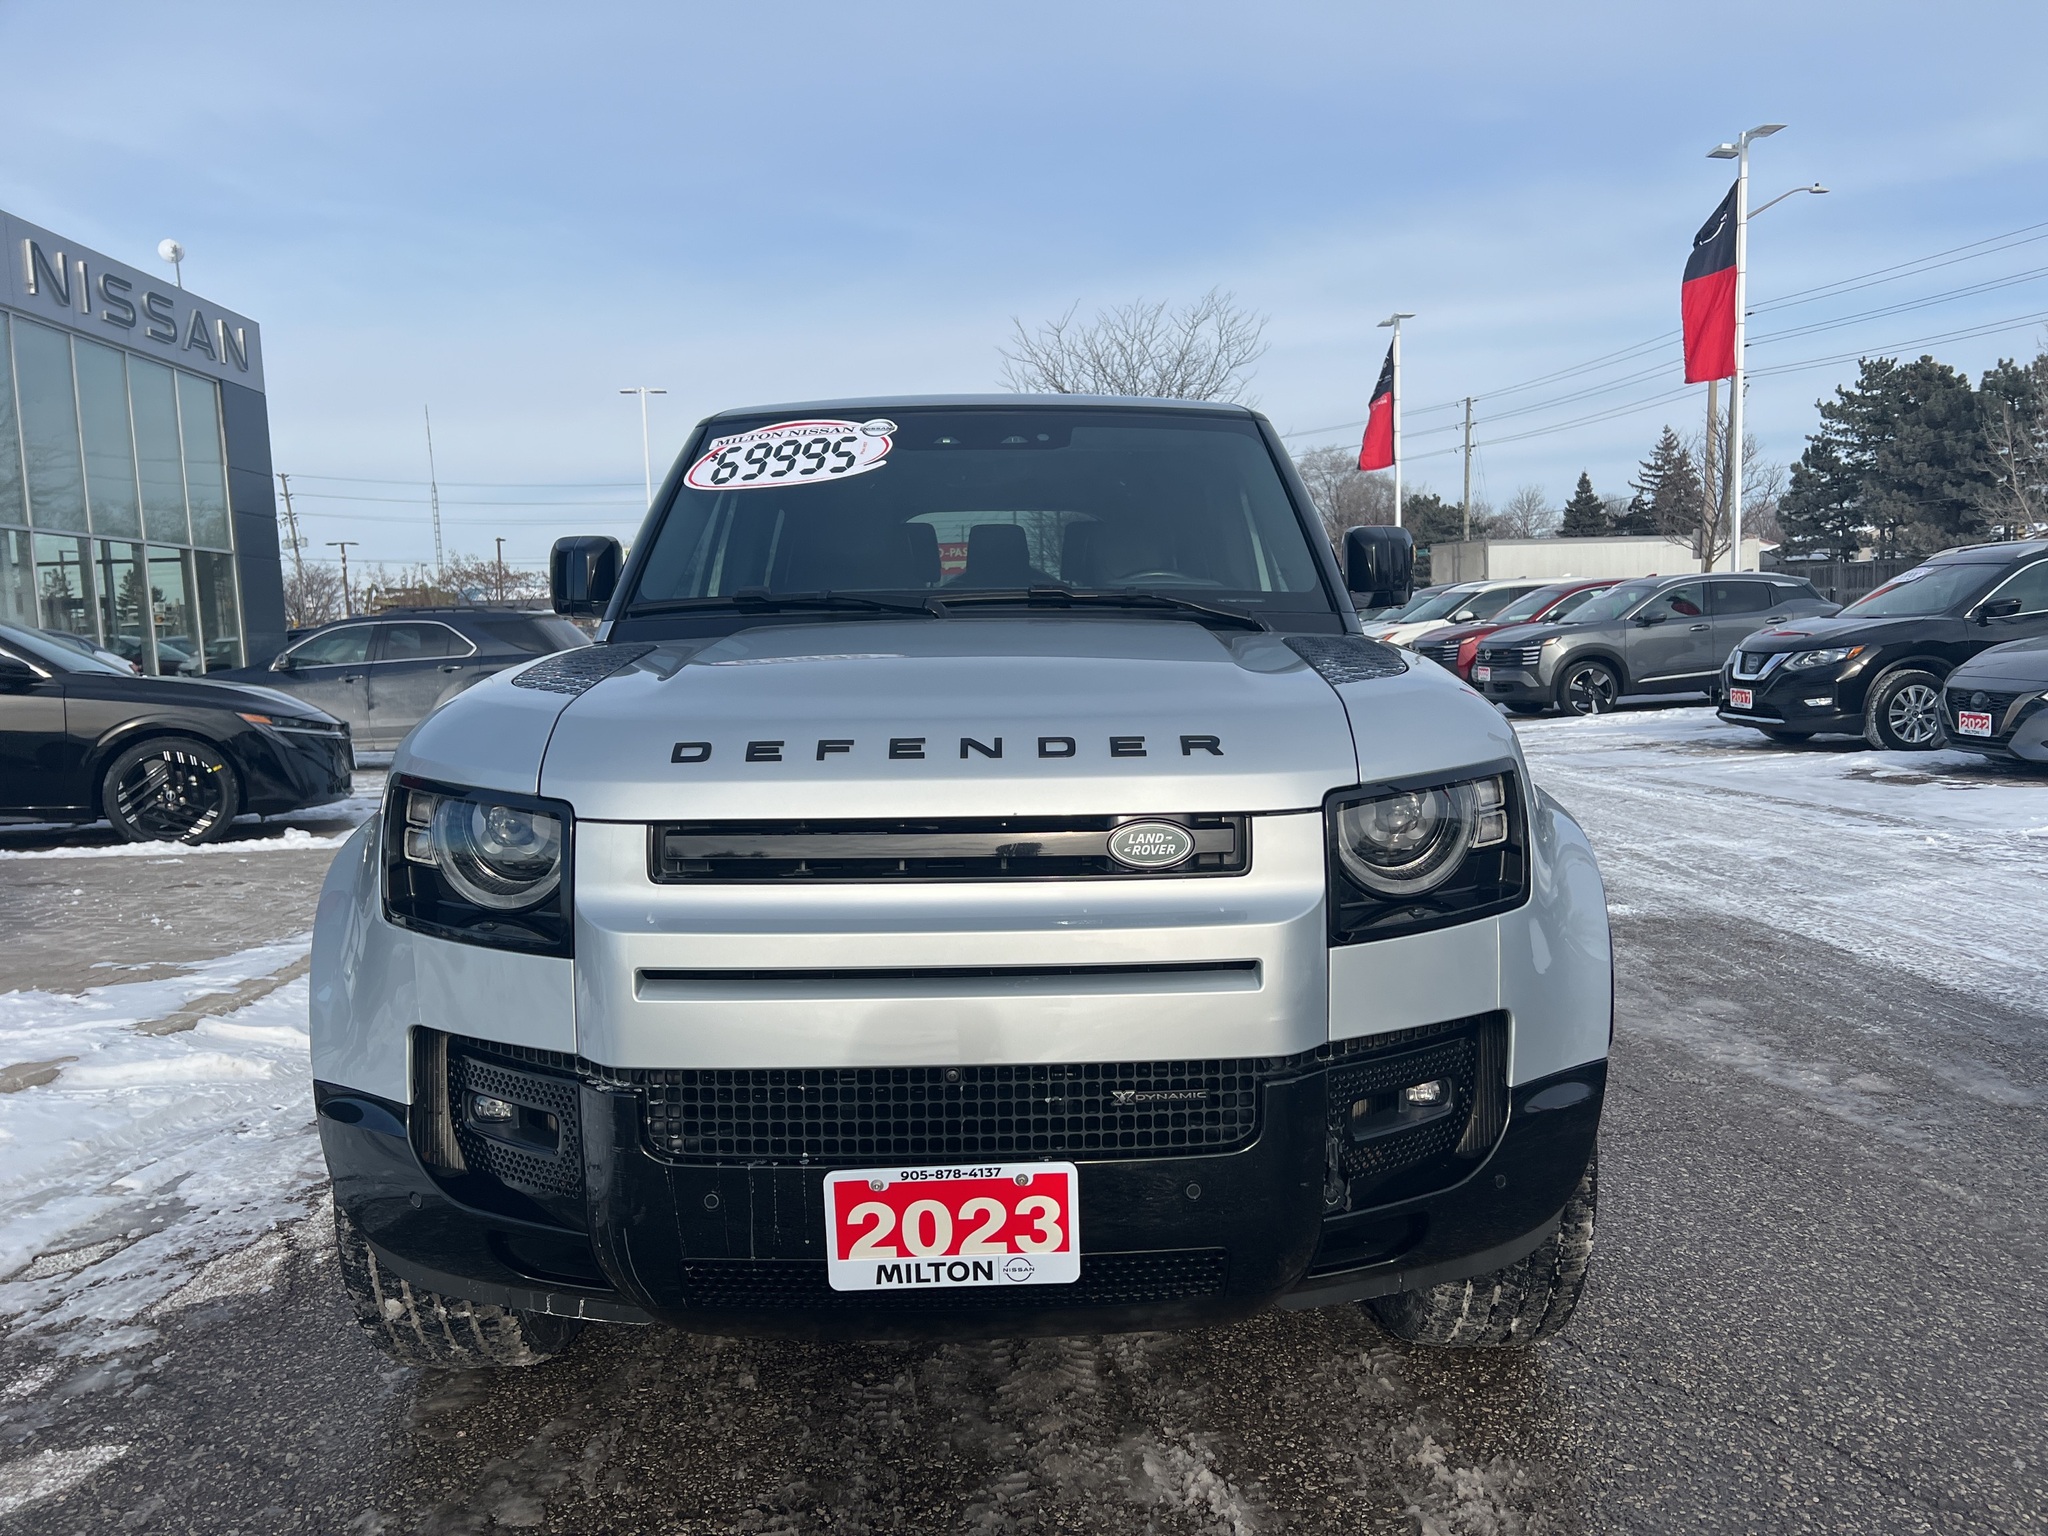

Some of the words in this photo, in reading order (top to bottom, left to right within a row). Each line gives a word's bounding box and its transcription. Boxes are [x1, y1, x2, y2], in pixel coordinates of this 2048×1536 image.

[24, 238, 249, 372] NISSAN
[717, 430, 786, 446] MILTON
[789, 427, 855, 438] NISSAN
[1732, 692, 1750, 704] 2017
[1961, 717, 1989, 730] 2022
[671, 735, 1224, 763] DEFENDER
[1128, 833, 1164, 844] LAND
[1132, 844, 1176, 855] ROVER
[1135, 1092, 1207, 1101] DYNAMIC
[900, 1167, 1001, 1181] 905-878-4137
[847, 1195, 1063, 1260] 2023
[876, 1260, 993, 1285] MILTON
[1002, 1265, 1035, 1273] NISSAN
